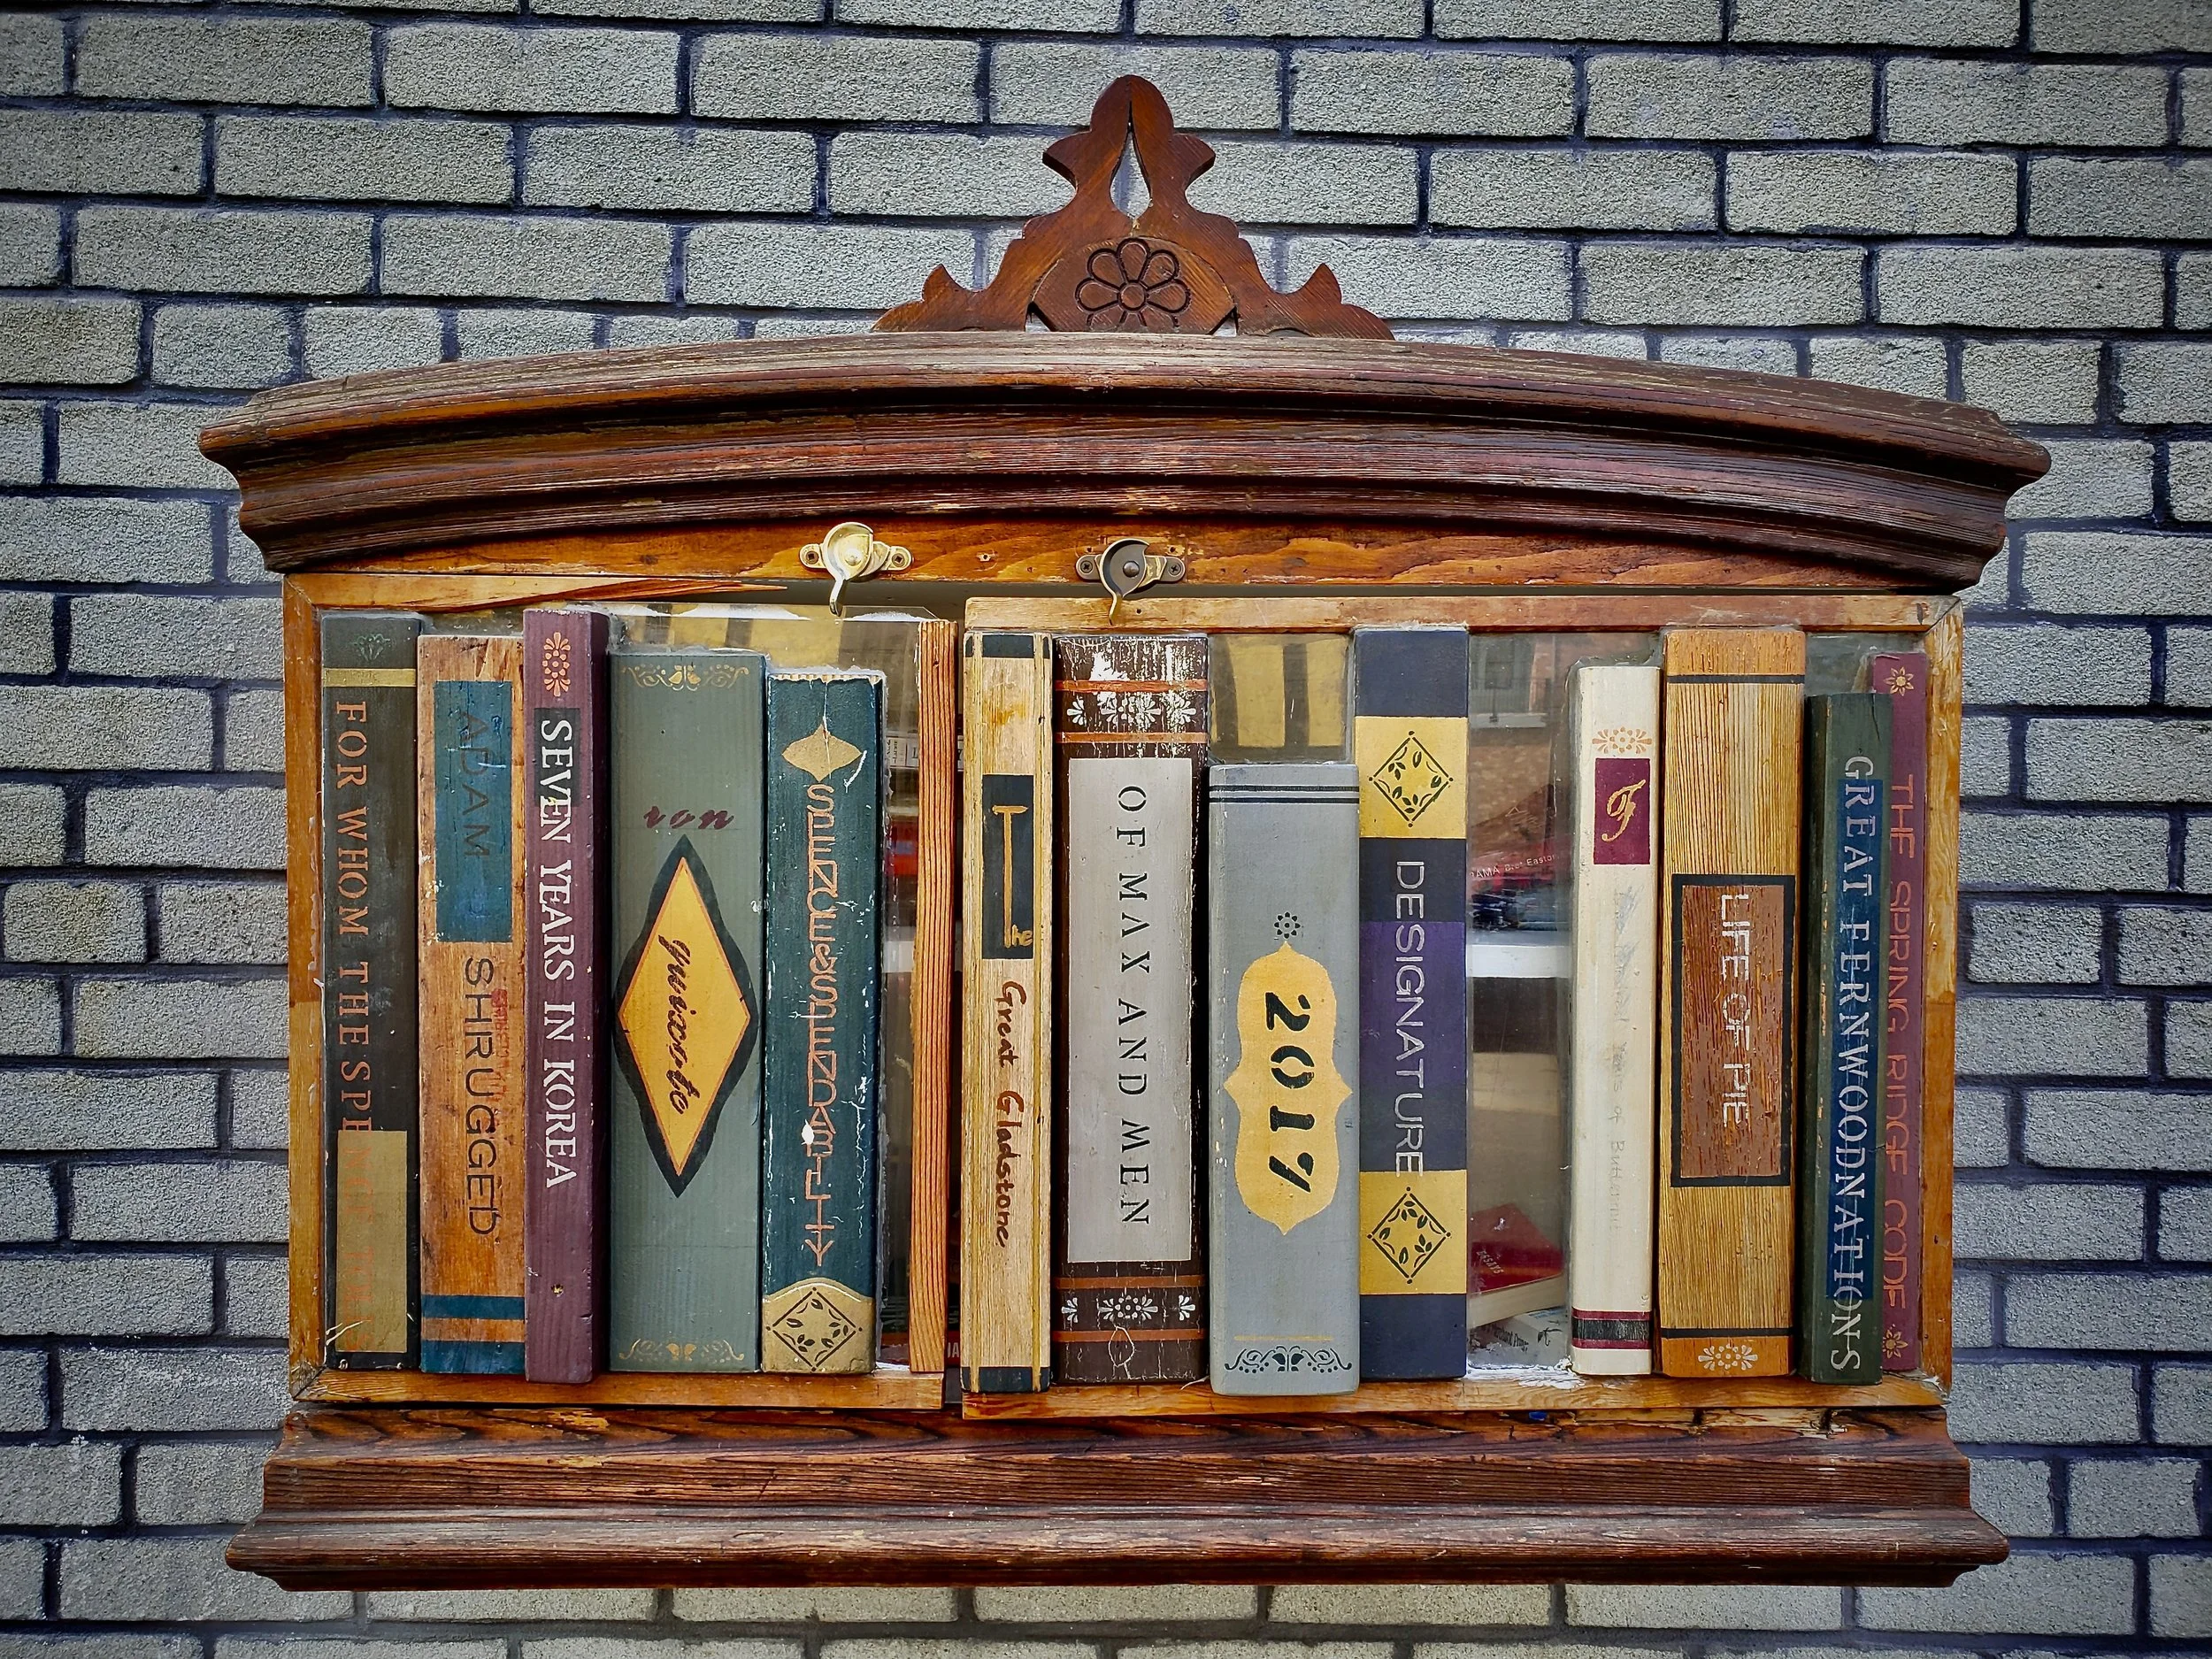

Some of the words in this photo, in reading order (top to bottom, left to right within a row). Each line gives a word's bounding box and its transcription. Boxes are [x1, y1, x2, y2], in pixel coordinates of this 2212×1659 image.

[336, 701, 368, 790] FOR
[458, 710, 492, 858] ADAM
[539, 718, 573, 844] SEVEN
[336, 805, 369, 936] WHOM
[1115, 785, 1148, 848] OF
[1843, 755, 1876, 896] GREAT
[1890, 773, 1915, 858] THE
[539, 859, 576, 982] YEARS
[992, 804, 1034, 949] The
[1118, 872, 1151, 974] MAX
[1720, 893, 1751, 981] LIFE
[1886, 880, 1912, 1034] SPRING
[337, 961, 370, 1046] THE
[543, 1001, 575, 1043] IN
[993, 980, 1027, 1069] Great
[1117, 997, 1148, 1096] AND
[1394, 860, 1425, 1178] DESIGNATURE
[1722, 992, 1753, 1052] OF
[465, 956, 501, 1236] SHRUGGED
[543, 1058, 578, 1189] KOREA
[1722, 1063, 1752, 1129] PIE
[1885, 1053, 1911, 1176] RIDGE
[995, 1090, 1026, 1248] Gladstone
[1118, 1117, 1151, 1225] MEN
[1882, 1198, 1909, 1310] CODE
